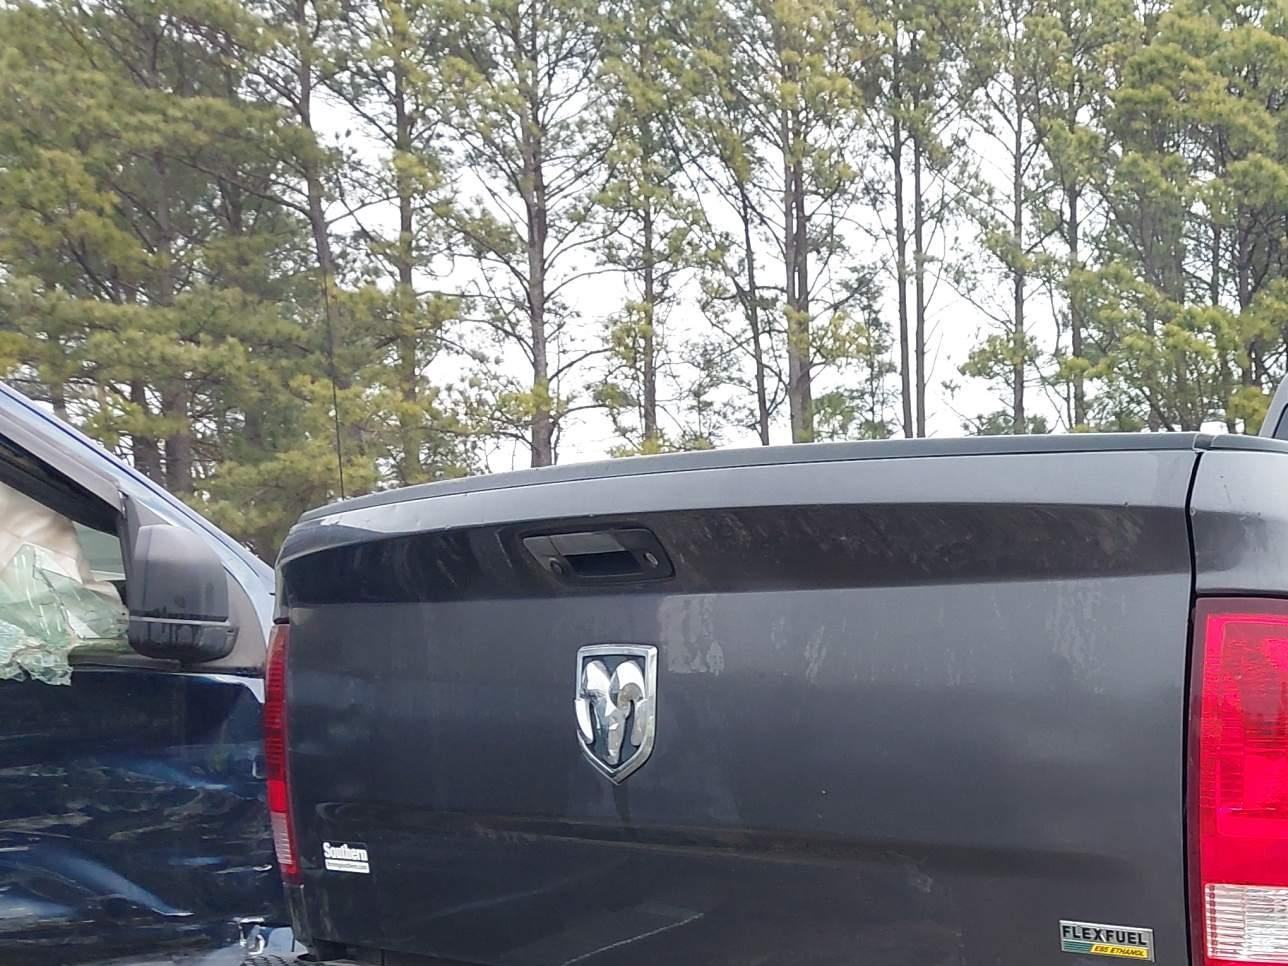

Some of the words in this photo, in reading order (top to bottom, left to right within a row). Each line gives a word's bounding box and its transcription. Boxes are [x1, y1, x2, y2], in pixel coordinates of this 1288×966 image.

[322, 842, 369, 861] Southern
[1061, 925, 1147, 946] FLEXFUEL
[1110, 947, 1146, 957] ETHANOL
